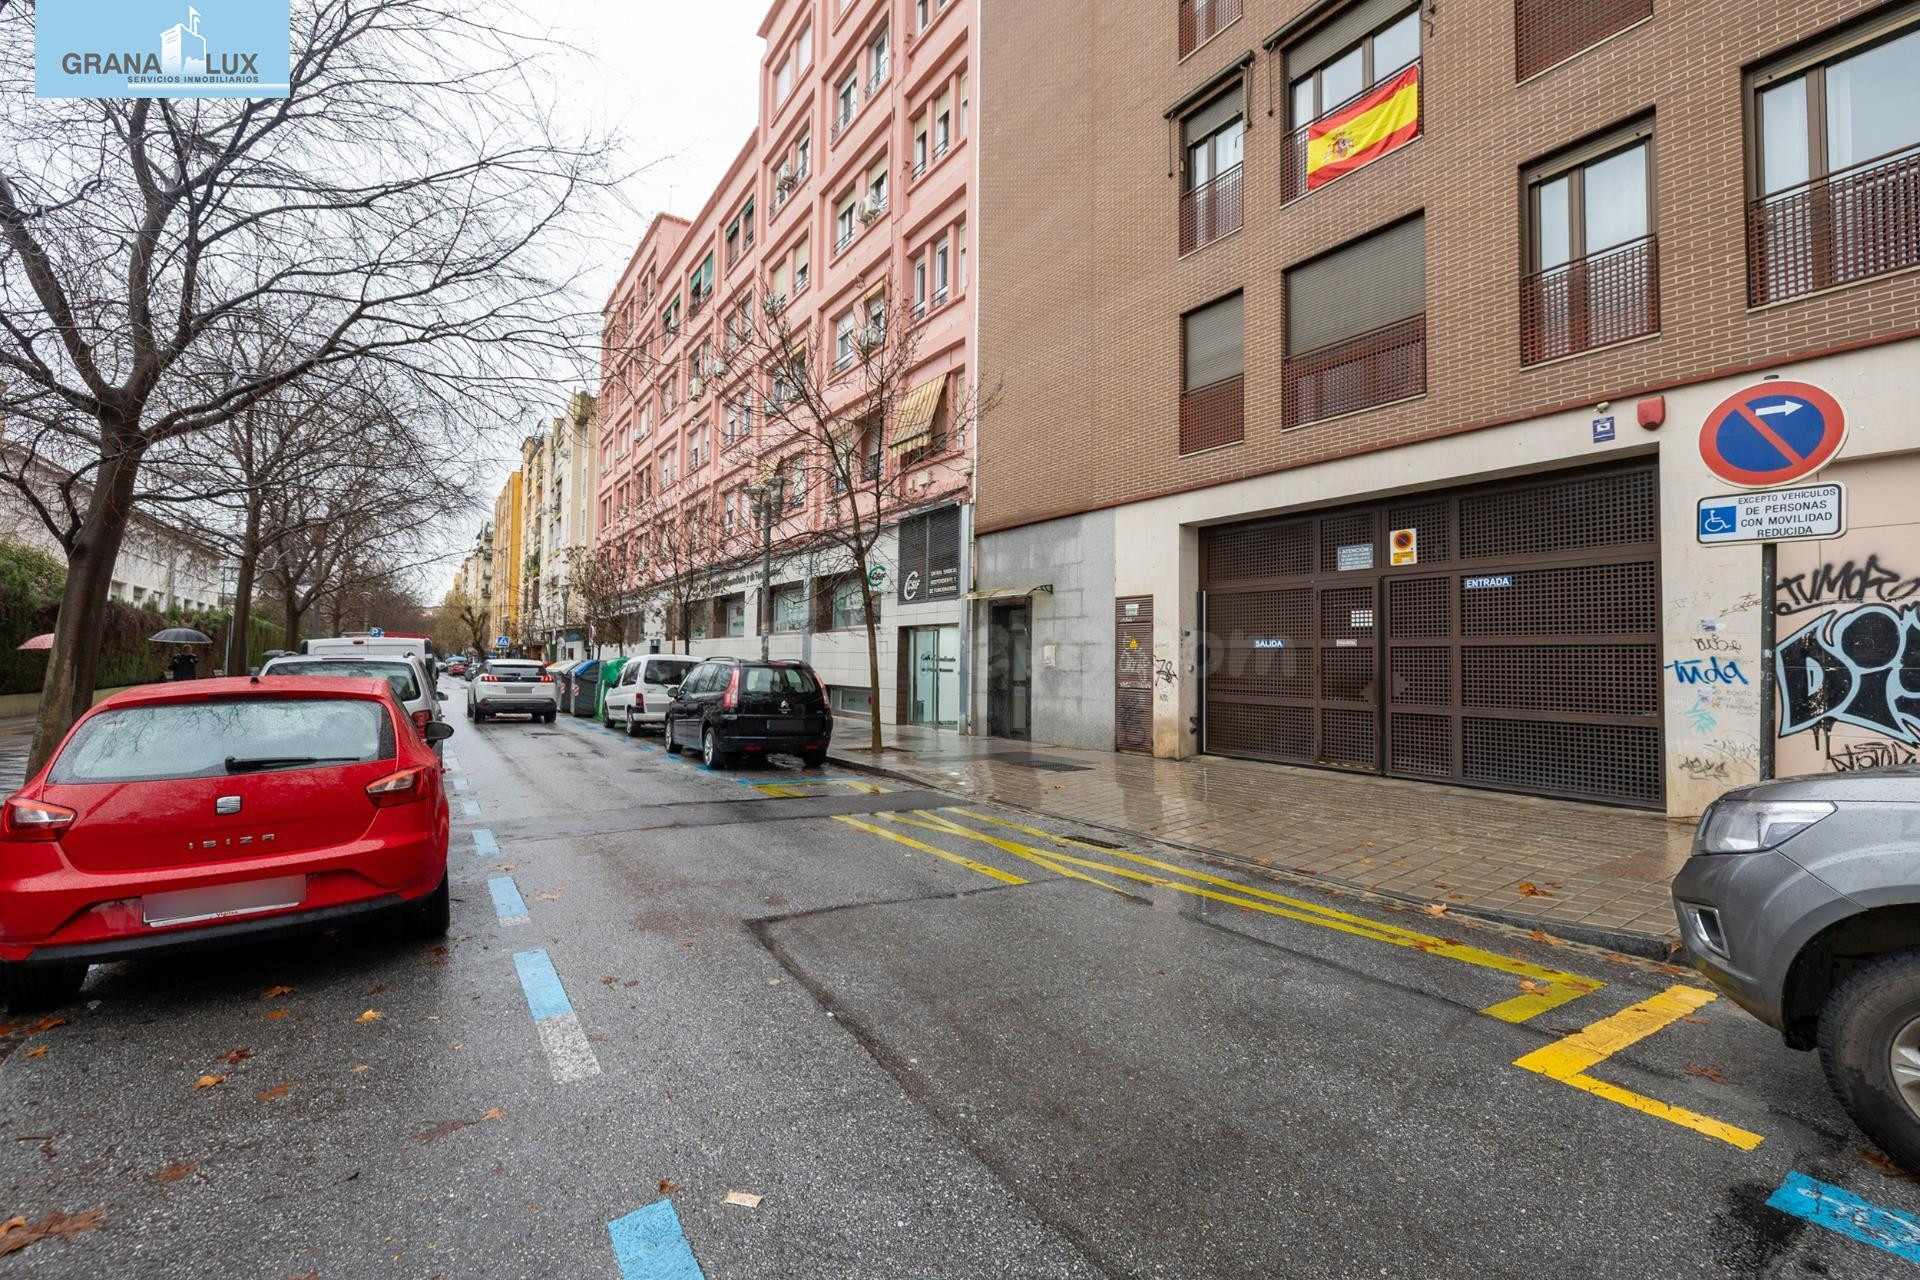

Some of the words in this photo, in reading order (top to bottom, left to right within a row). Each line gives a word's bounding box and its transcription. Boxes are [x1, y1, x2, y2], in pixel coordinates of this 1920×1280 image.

[1738, 494, 1778, 505] EXCEPTO
[1745, 507, 1760, 516] DE
[1765, 500, 1827, 514] PERSONAS
[1740, 518, 1763, 528] CON
[1768, 512, 1833, 526] MOVILIDAD
[1757, 526, 1814, 538] REDUCIDA
[1466, 577, 1509, 588] ENTRADA
[1255, 639, 1283, 648] SALIDA
[188, 833, 275, 850] IBIZA
